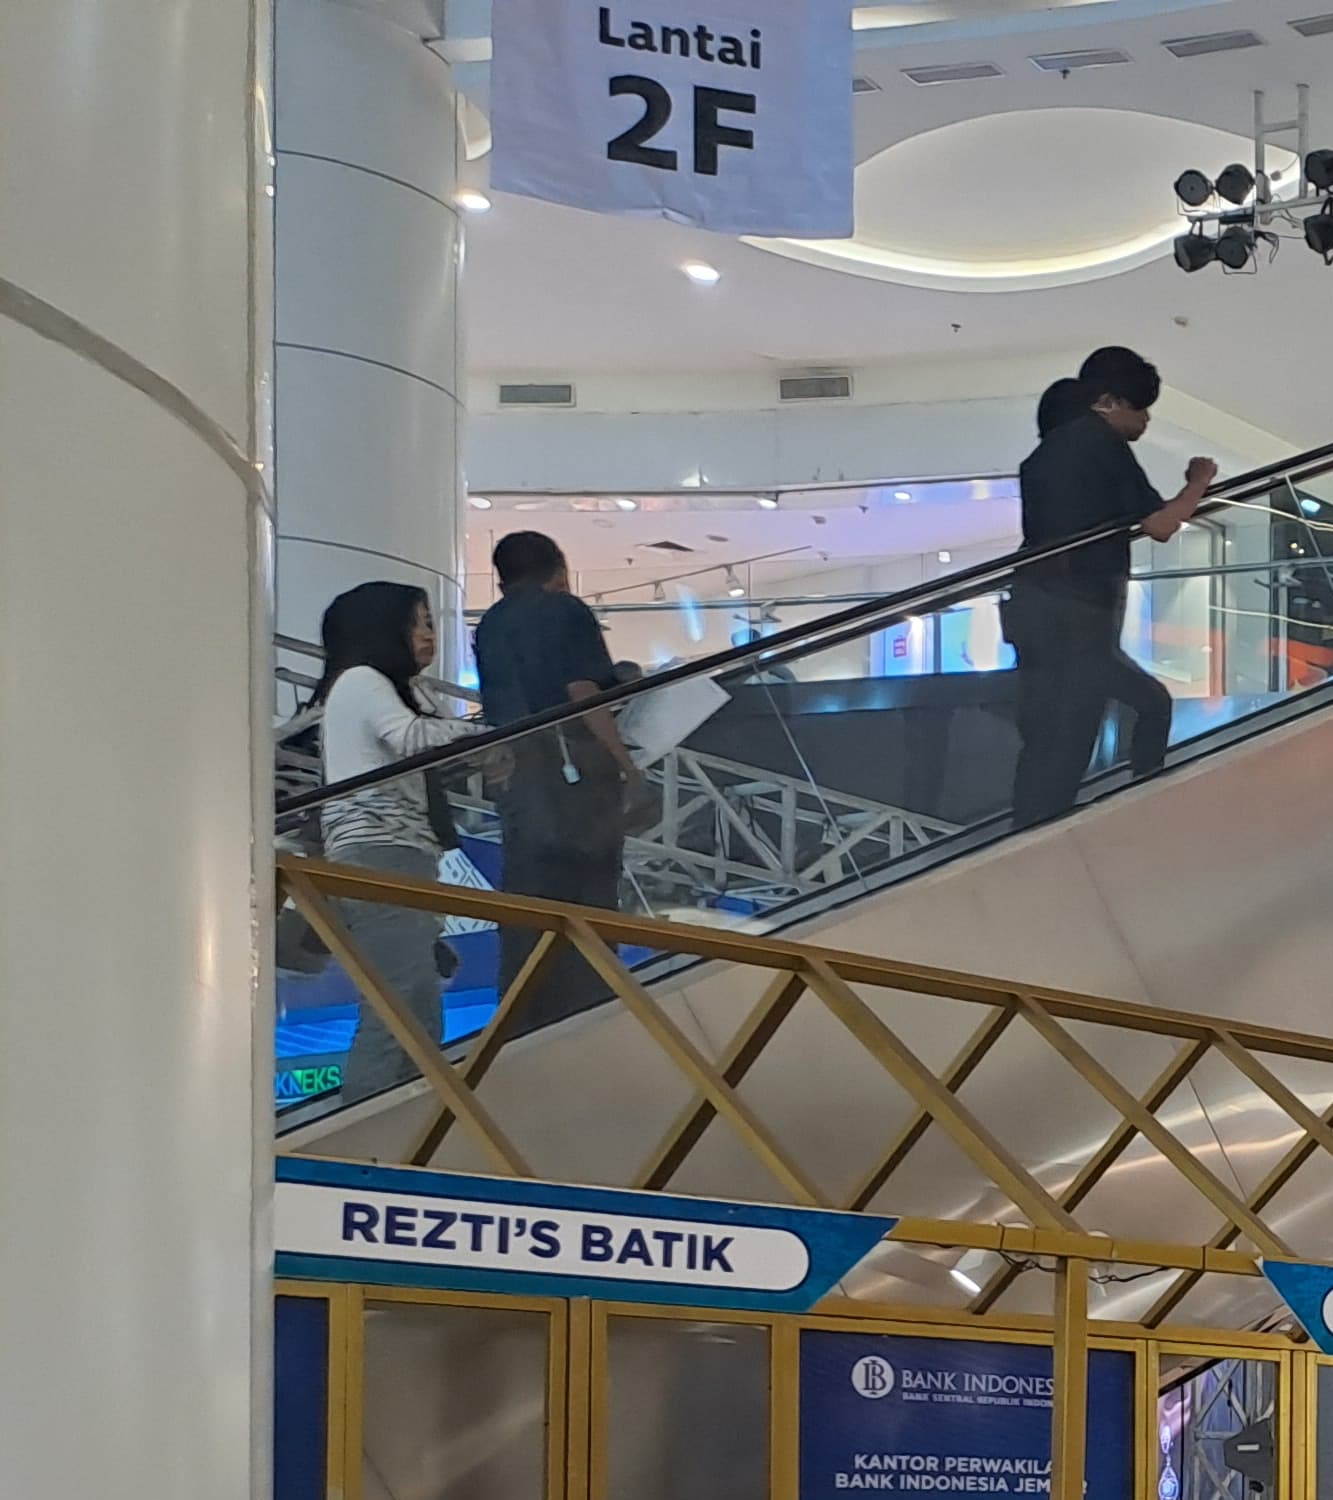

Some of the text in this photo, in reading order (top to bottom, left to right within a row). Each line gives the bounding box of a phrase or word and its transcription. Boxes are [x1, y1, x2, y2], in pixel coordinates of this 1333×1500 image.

[599, 6, 761, 69] Lantai
[607, 74, 757, 176] 2F
[341, 1201, 735, 1273] REZTI'S BATIK
[901, 1368, 1054, 1398] BANK INDONES
[835, 1472, 894, 1491] BANK
[900, 1474, 1009, 1494] INDONESIA
[854, 1453, 1053, 1475] KANTOR PERWAKIL
